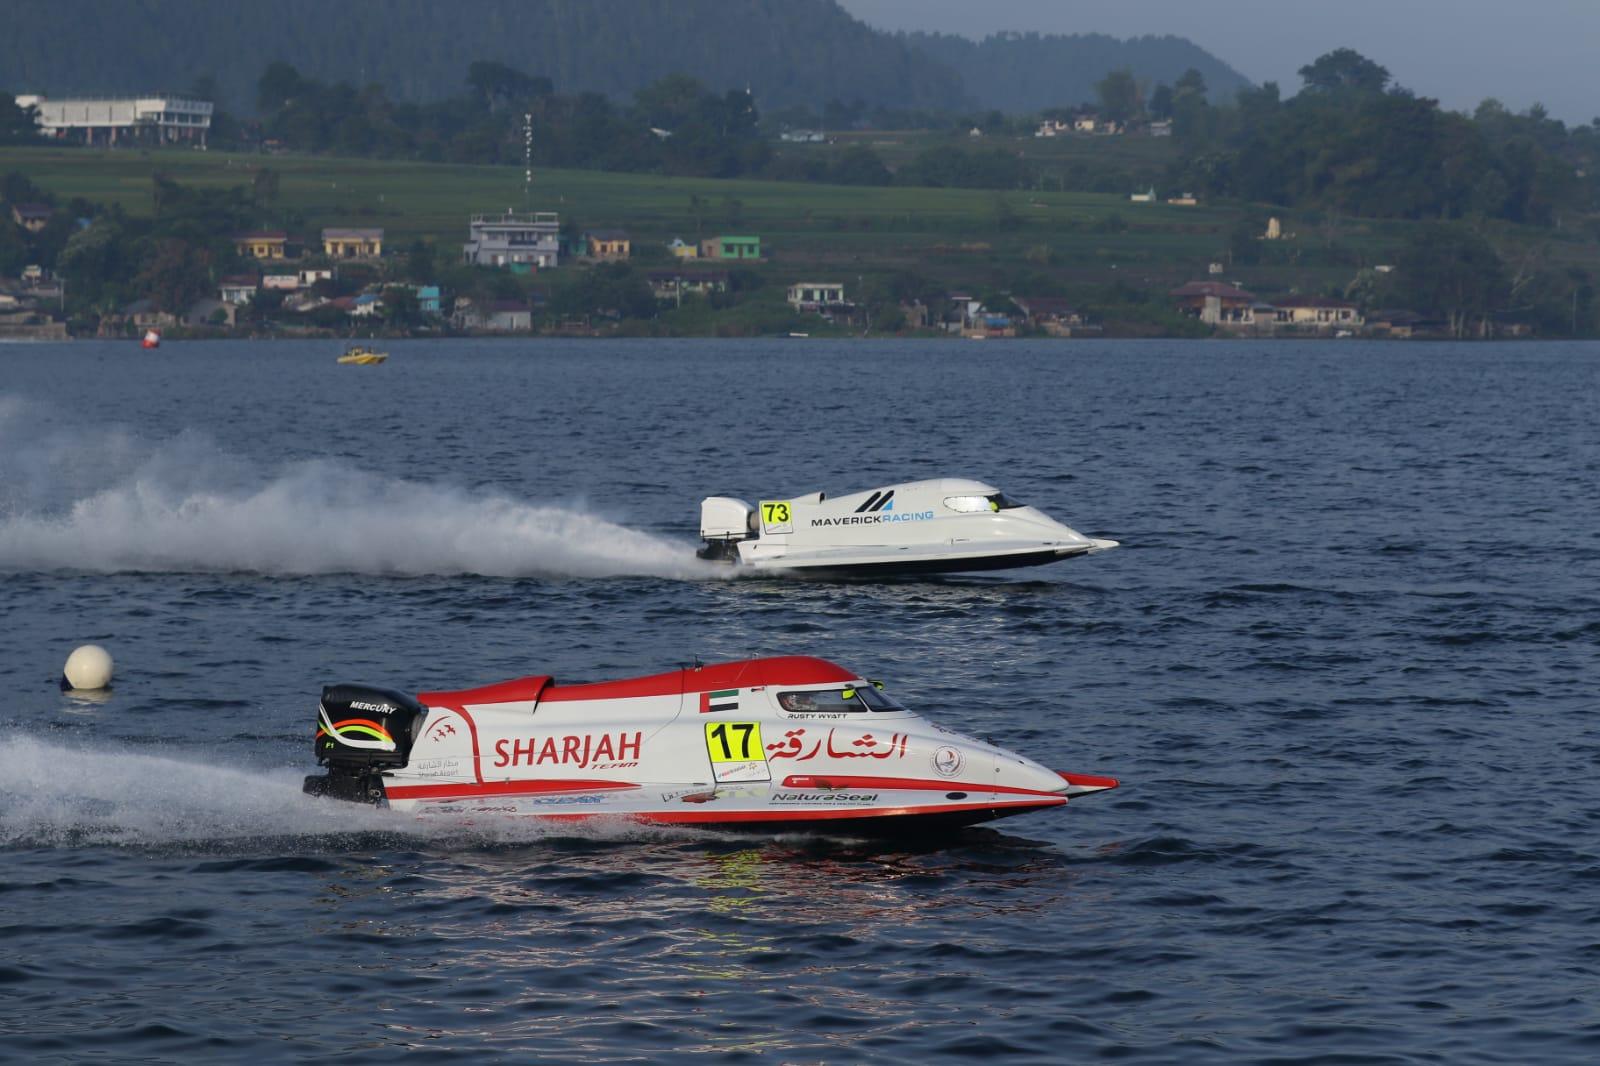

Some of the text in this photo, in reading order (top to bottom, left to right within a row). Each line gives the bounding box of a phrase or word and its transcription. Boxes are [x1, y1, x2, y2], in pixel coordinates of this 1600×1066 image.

[763, 503, 789, 522] 73
[350, 701, 397, 714] MERCURY
[494, 732, 642, 769] SHARJAH
[711, 723, 754, 759] 17
[766, 727, 908, 762] الشارقة
[772, 793, 879, 801] NaturaSeal
